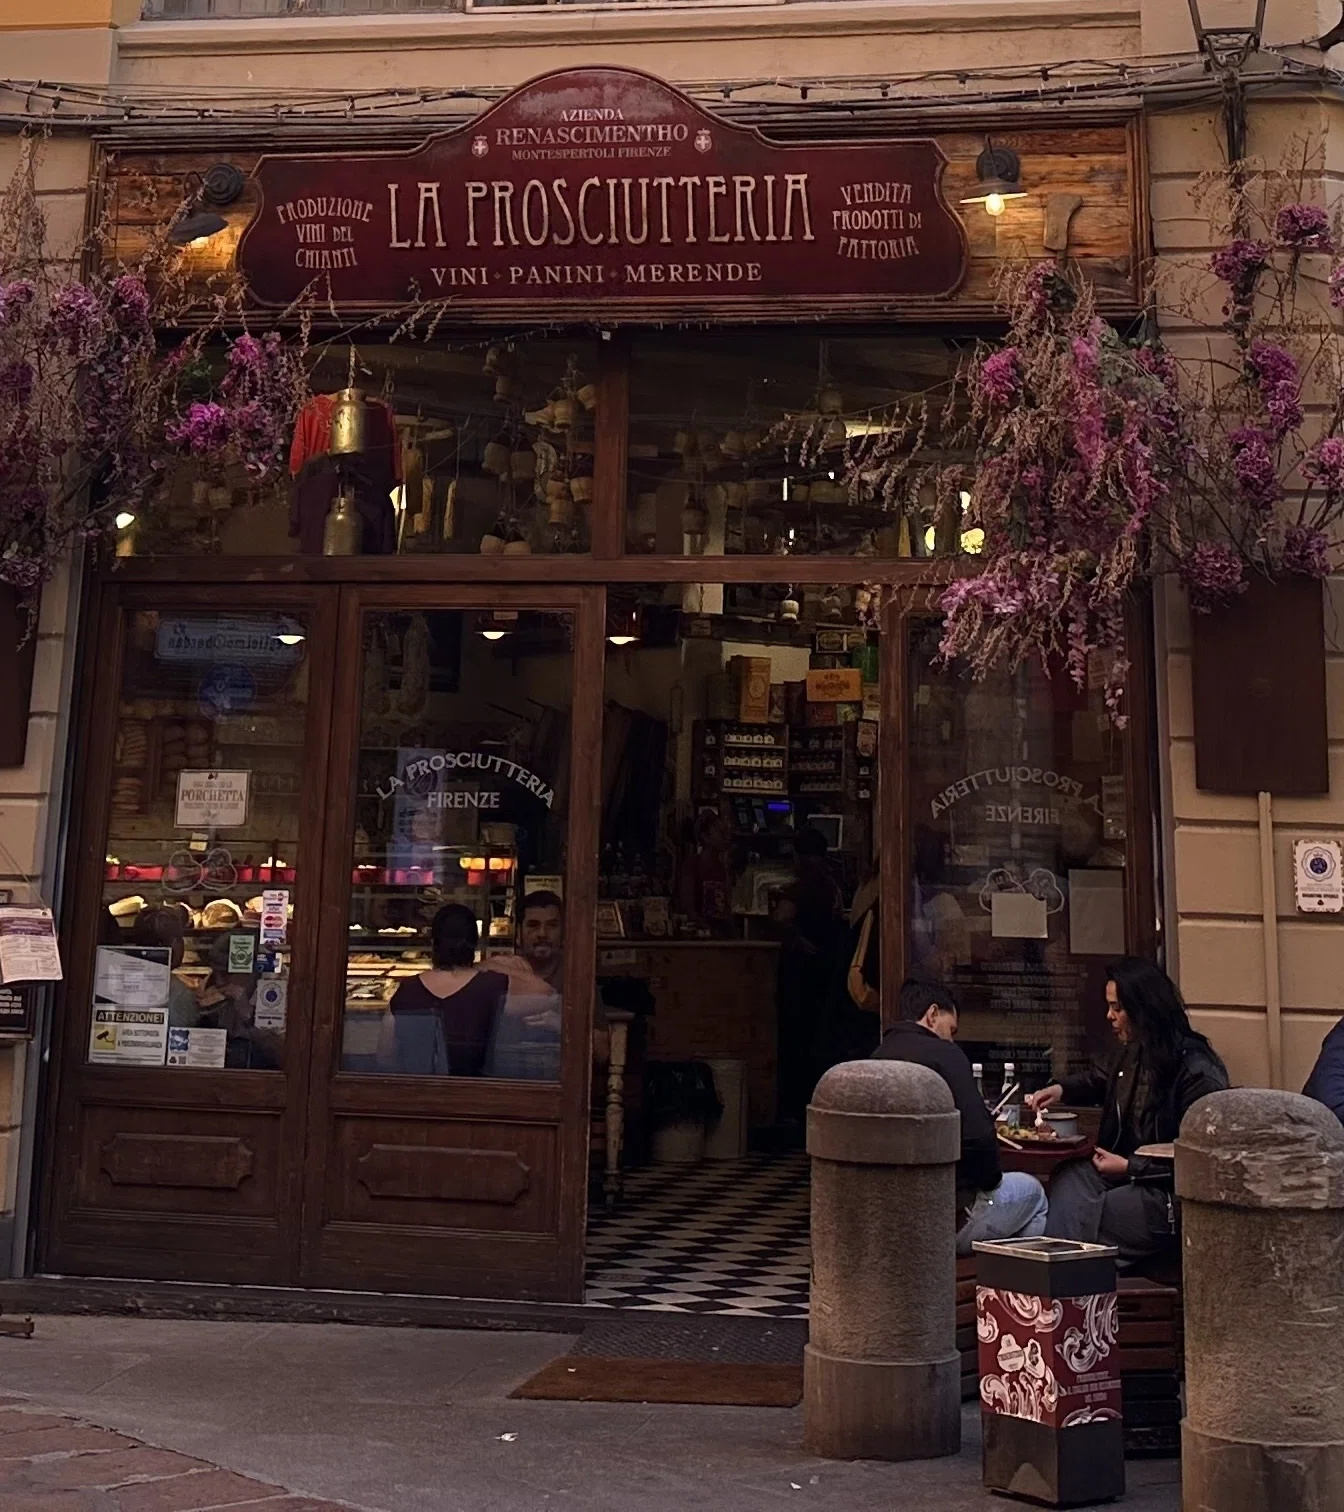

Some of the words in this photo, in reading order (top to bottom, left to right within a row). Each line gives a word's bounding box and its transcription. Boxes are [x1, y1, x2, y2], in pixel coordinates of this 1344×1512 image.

[559, 108, 625, 123] AZIENDA
[495, 123, 689, 147] RENASCIMENTHO
[511, 147, 615, 161] MONTESPERTOLI
[617, 146, 671, 159] FIRENZE
[840, 182, 913, 206] VENDITA
[276, 196, 373, 224] PRODUZIONE
[387, 181, 447, 249] LA
[464, 173, 816, 249] PROSCIUTTERIA
[832, 210, 905, 231] PRODOTTI
[295, 224, 327, 243] VINI
[333, 225, 355, 242] DEL
[295, 248, 358, 269] CHIANTI
[836, 236, 920, 260] FATTORIA
[430, 268, 489, 286] VINI
[509, 266, 605, 286] PANINI
[624, 262, 763, 284] MERENDE
[375, 775, 405, 801] LA
[405, 752, 556, 809] PROSCIUTTERIA
[181, 789, 244, 802] PORCHETTA
[427, 791, 501, 809] FIRENZE
[97, 1011, 164, 1024] ATTENZIONE!
